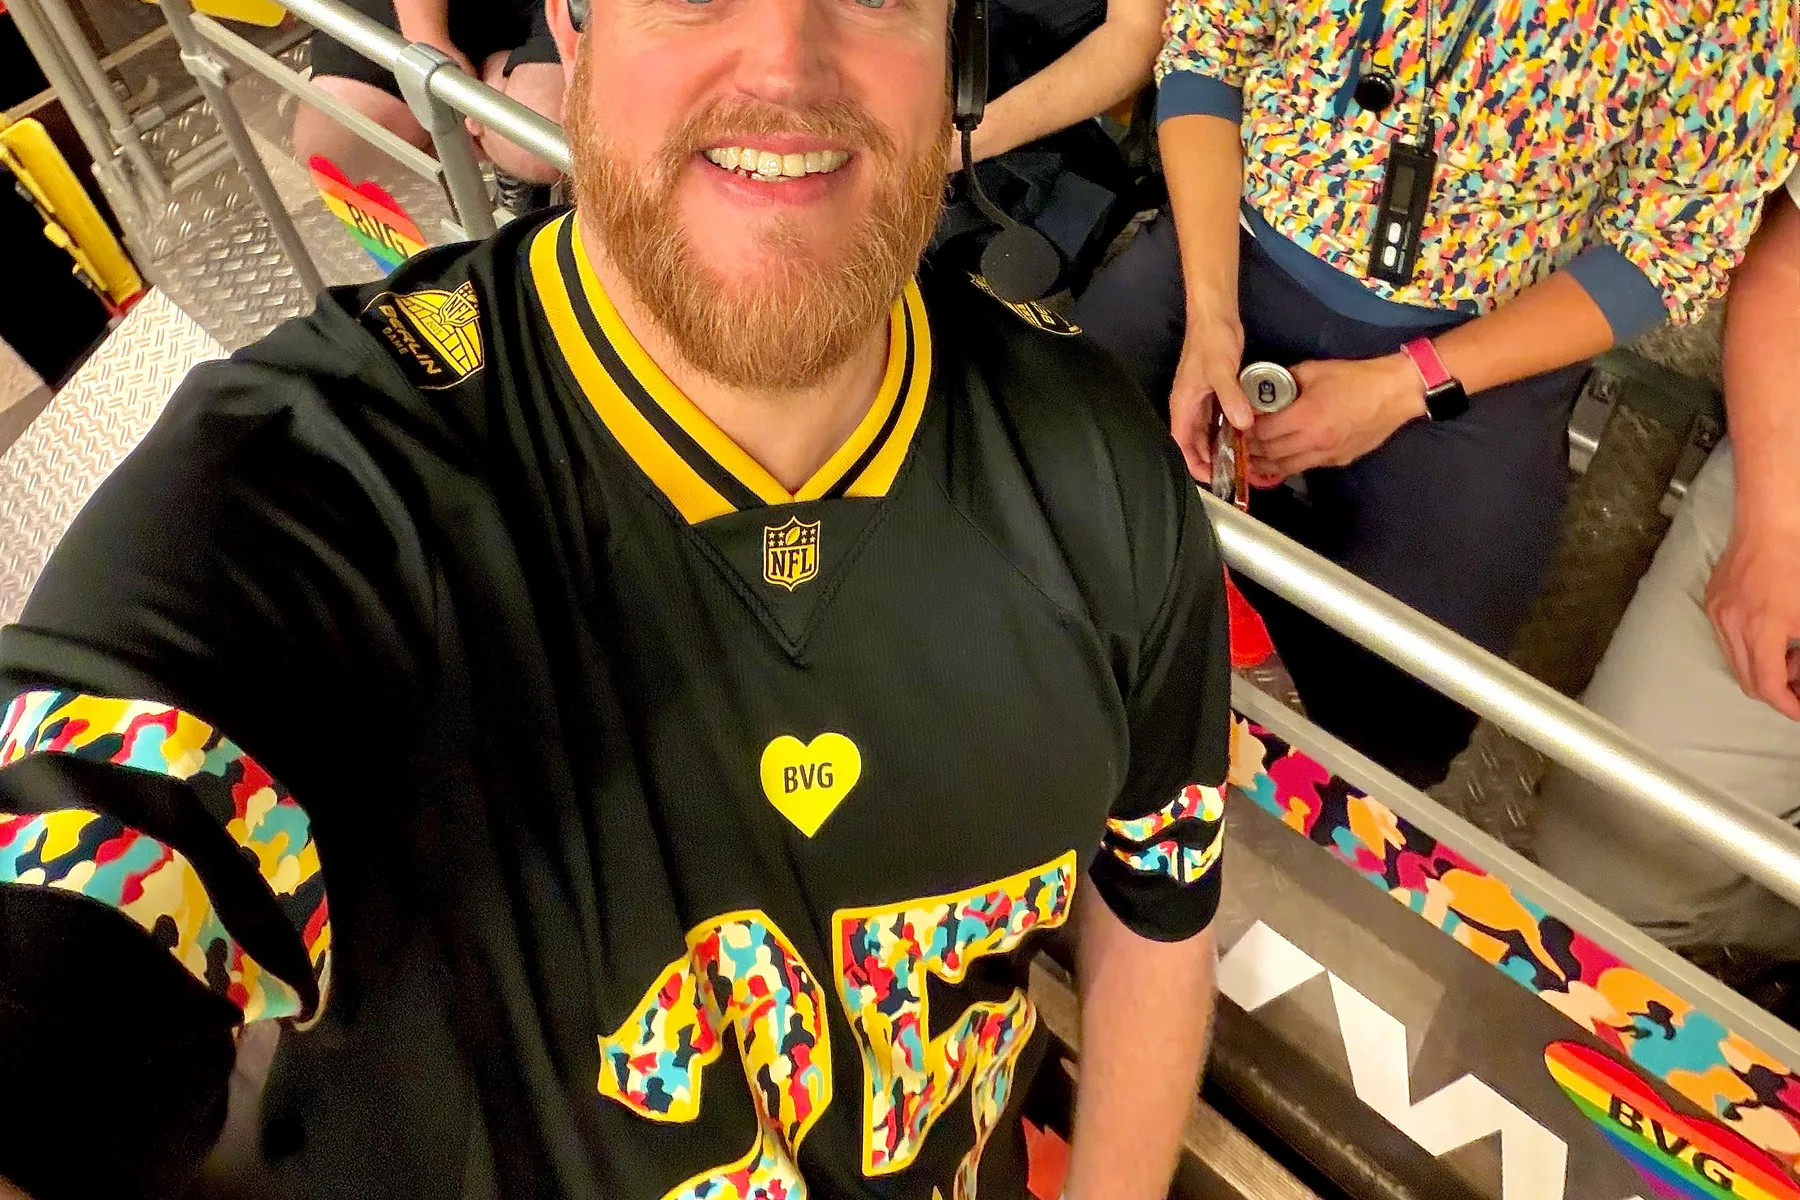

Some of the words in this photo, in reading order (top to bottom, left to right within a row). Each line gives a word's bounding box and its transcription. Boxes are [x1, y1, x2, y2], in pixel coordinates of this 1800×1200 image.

[343, 199, 409, 260] BVG
[443, 295, 474, 323] NFL
[378, 305, 442, 374] BERLIN
[382, 327, 409, 355] GAME
[770, 548, 813, 580] NFL
[783, 762, 834, 794] BVG
[1609, 1093, 1735, 1192] BVG
